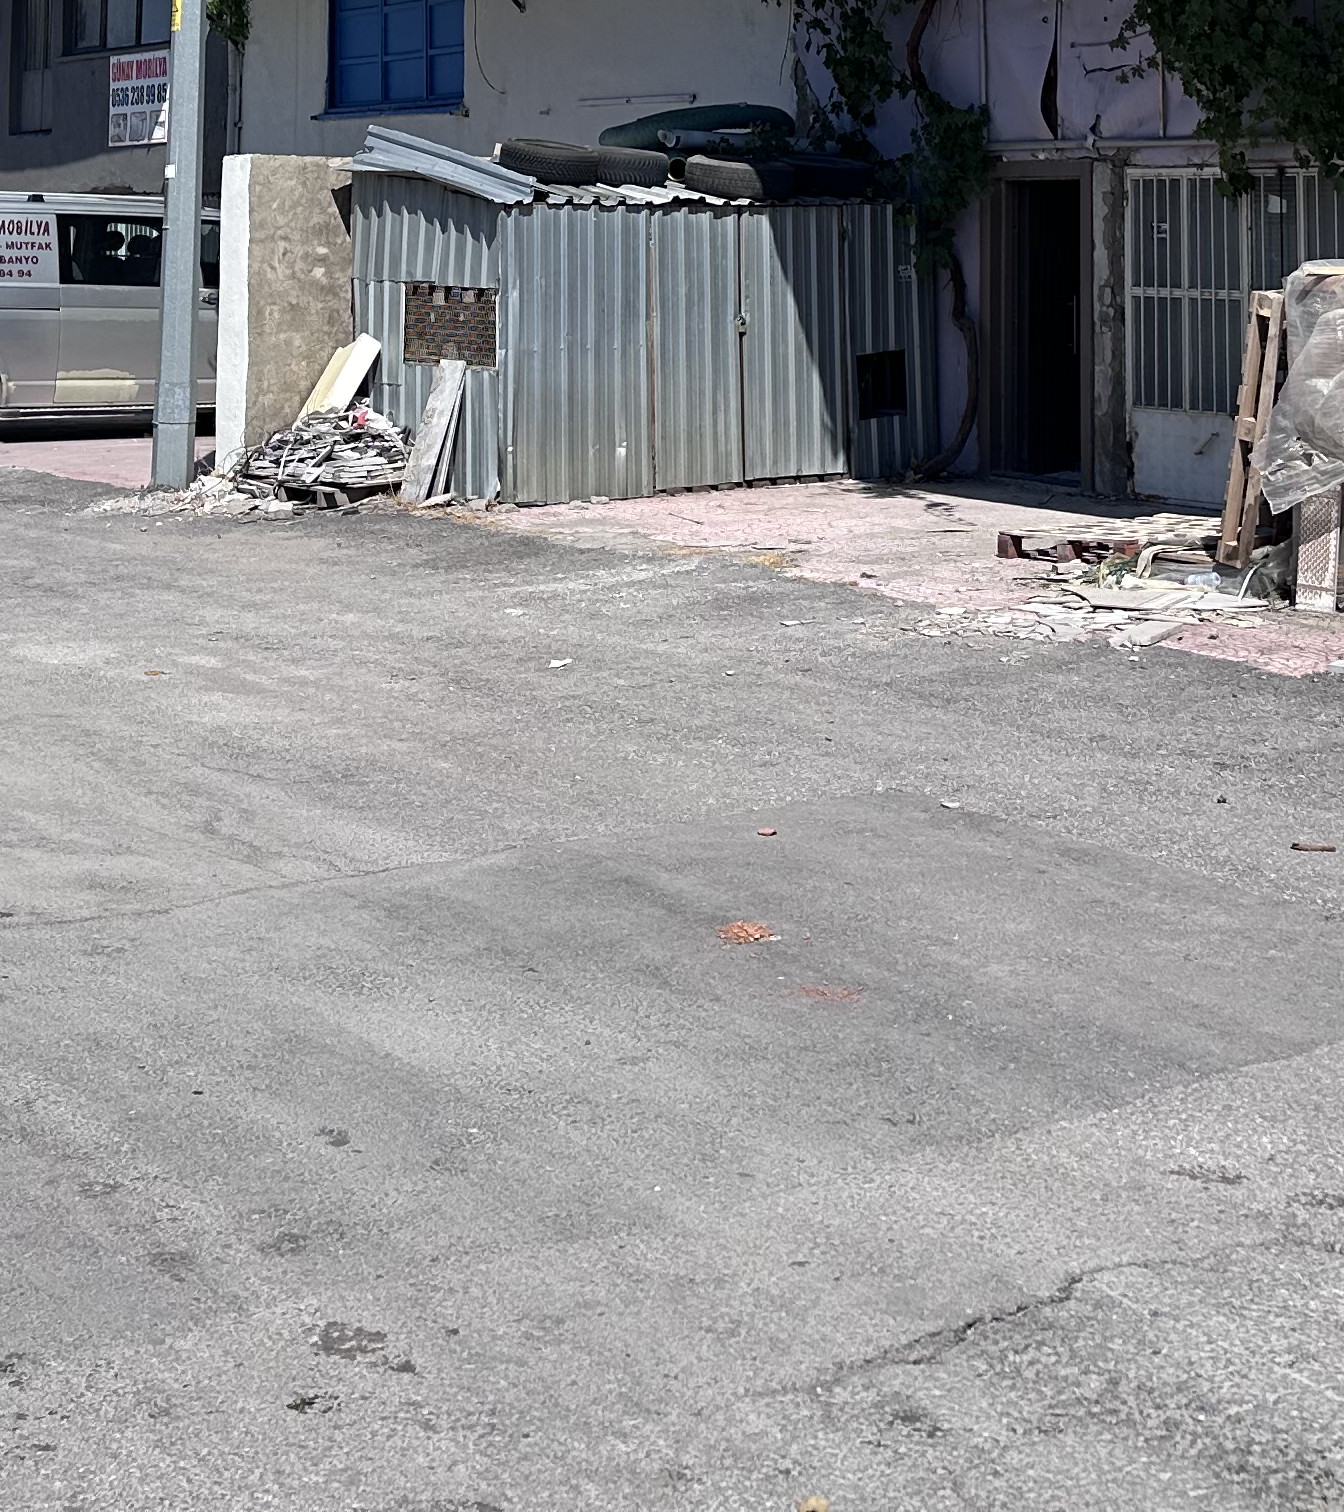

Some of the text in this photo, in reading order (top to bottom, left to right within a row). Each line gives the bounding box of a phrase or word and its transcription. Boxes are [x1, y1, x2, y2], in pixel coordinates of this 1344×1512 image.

[112, 54, 167, 82] GÜNAY MOBİLYA
[111, 82, 168, 108] 0536 238 99 85
[5, 240, 53, 251] MUTFAK
[0, 254, 39, 265] BANYO
[17, 269, 33, 278] 94
